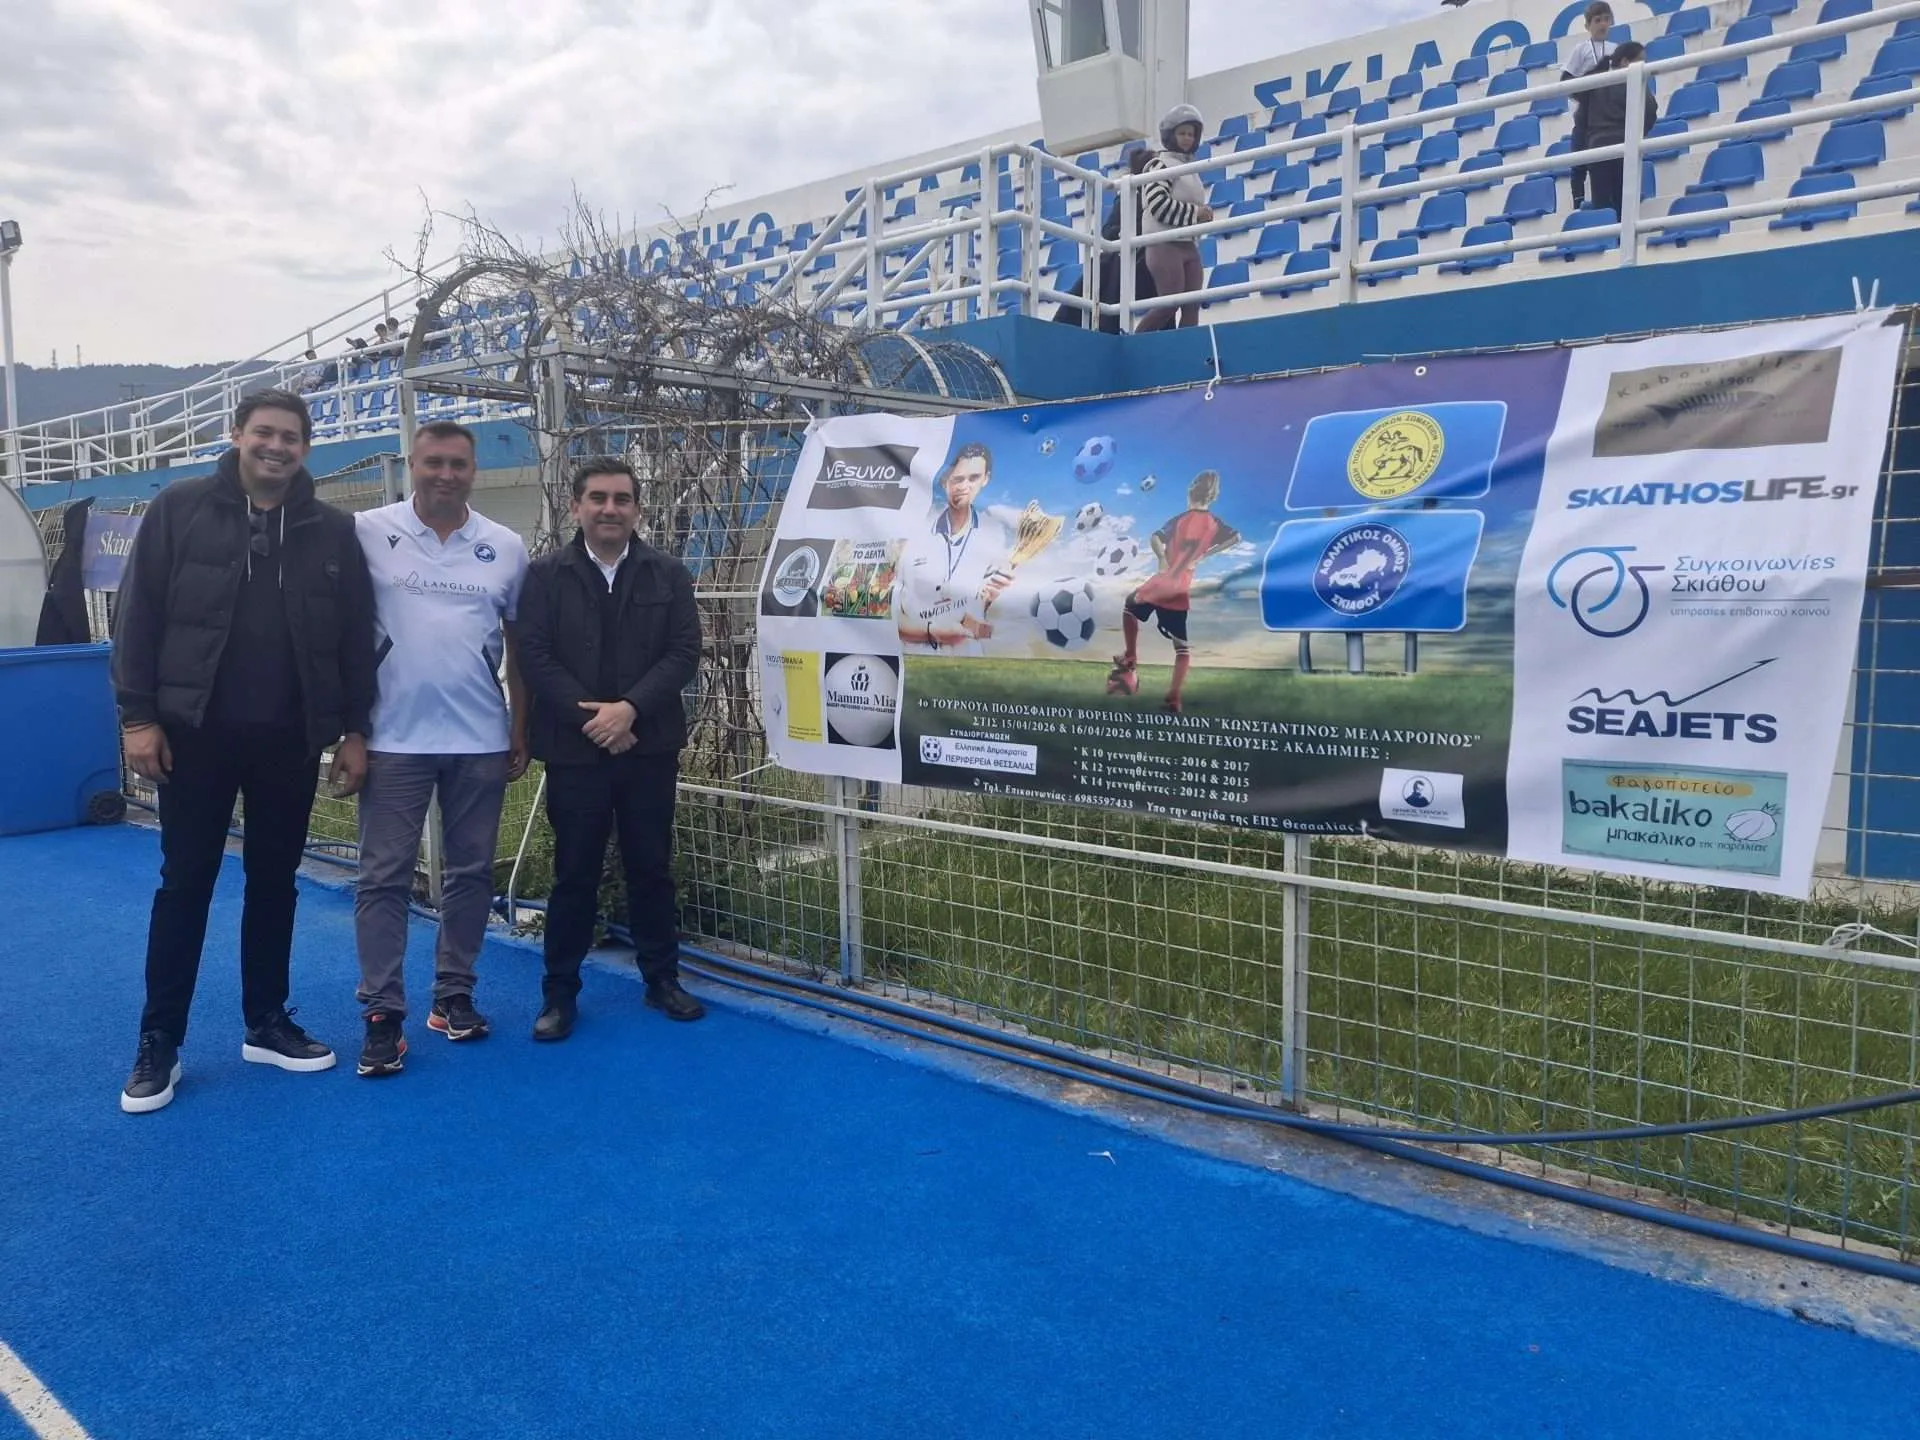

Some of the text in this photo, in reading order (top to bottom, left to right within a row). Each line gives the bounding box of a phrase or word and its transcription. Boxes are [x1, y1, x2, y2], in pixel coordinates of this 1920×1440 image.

[826, 460, 897, 480] VESUVIO
[1566, 475, 1858, 510] SKIATHOSLIFE.gr
[864, 549, 887, 559] ΔΕΛΤΑ
[1320, 529, 1405, 575] ΑΘΛΗΤΙΚΟΣ ΟΜΙΛΟΣ
[423, 579, 488, 594] LANGLOIS
[1671, 574, 1766, 593] Σκιάθου
[1331, 591, 1381, 610] ΣΚΙΑΘΟΥ
[827, 690, 869, 706] Mamma
[873, 694, 897, 708] Mia
[949, 728, 1010, 741] ΣΥΝΔΙΟΡΓΑΝΩΣΗ
[992, 703, 1074, 718] ΠΟΔΟΣΦΑΙΡΟΥ
[1078, 710, 1132, 722] ΒΟΡΕΙΩΝ
[1136, 713, 1210, 728] ΣΠΟΡΑΔΩΝ
[1344, 727, 1481, 747] ΜΕΛΑΧΡΟΙΝΟΣ"
[1566, 706, 1778, 744] SEAJETS
[972, 716, 998, 727] ΣΤΙΣ
[1002, 719, 1056, 732] 15/04/2026
[1059, 723, 1067, 733] &
[1071, 724, 1132, 738] 16/04/2026
[1135, 729, 1154, 741] ΜΕ
[1157, 731, 1279, 751] ΣΥΜΜΕΤΕΧΟΥΣΕΣ
[1283, 741, 1380, 759] ΑΚΑΔΗΜΙΕΣ
[945, 754, 1035, 771] ΠΕΡΙΦΕΡΕΙΑ ΘΕΣΣΑΛΙΑΣ
[1093, 748, 1103, 758] 10
[1181, 756, 1207, 768] 2016
[1210, 759, 1220, 769] &
[1223, 760, 1250, 772] 2017
[1093, 762, 1103, 772] 12
[1181, 771, 1206, 783] 2014
[1210, 774, 1219, 784] &
[1223, 775, 1250, 787] 2015
[1092, 776, 1102, 787] 14
[1180, 786, 1206, 798] 2012
[1209, 789, 1218, 800] &
[1222, 790, 1249, 804] 2013
[983, 782, 1002, 794] Τηλ.
[1075, 793, 1133, 808] 6985597433
[1169, 806, 1188, 818] την
[1191, 807, 1226, 822] αιγίδα
[1230, 813, 1249, 826] της
[1253, 815, 1279, 828] ΕΠΣ
[1568, 790, 1712, 827] bakaliko
